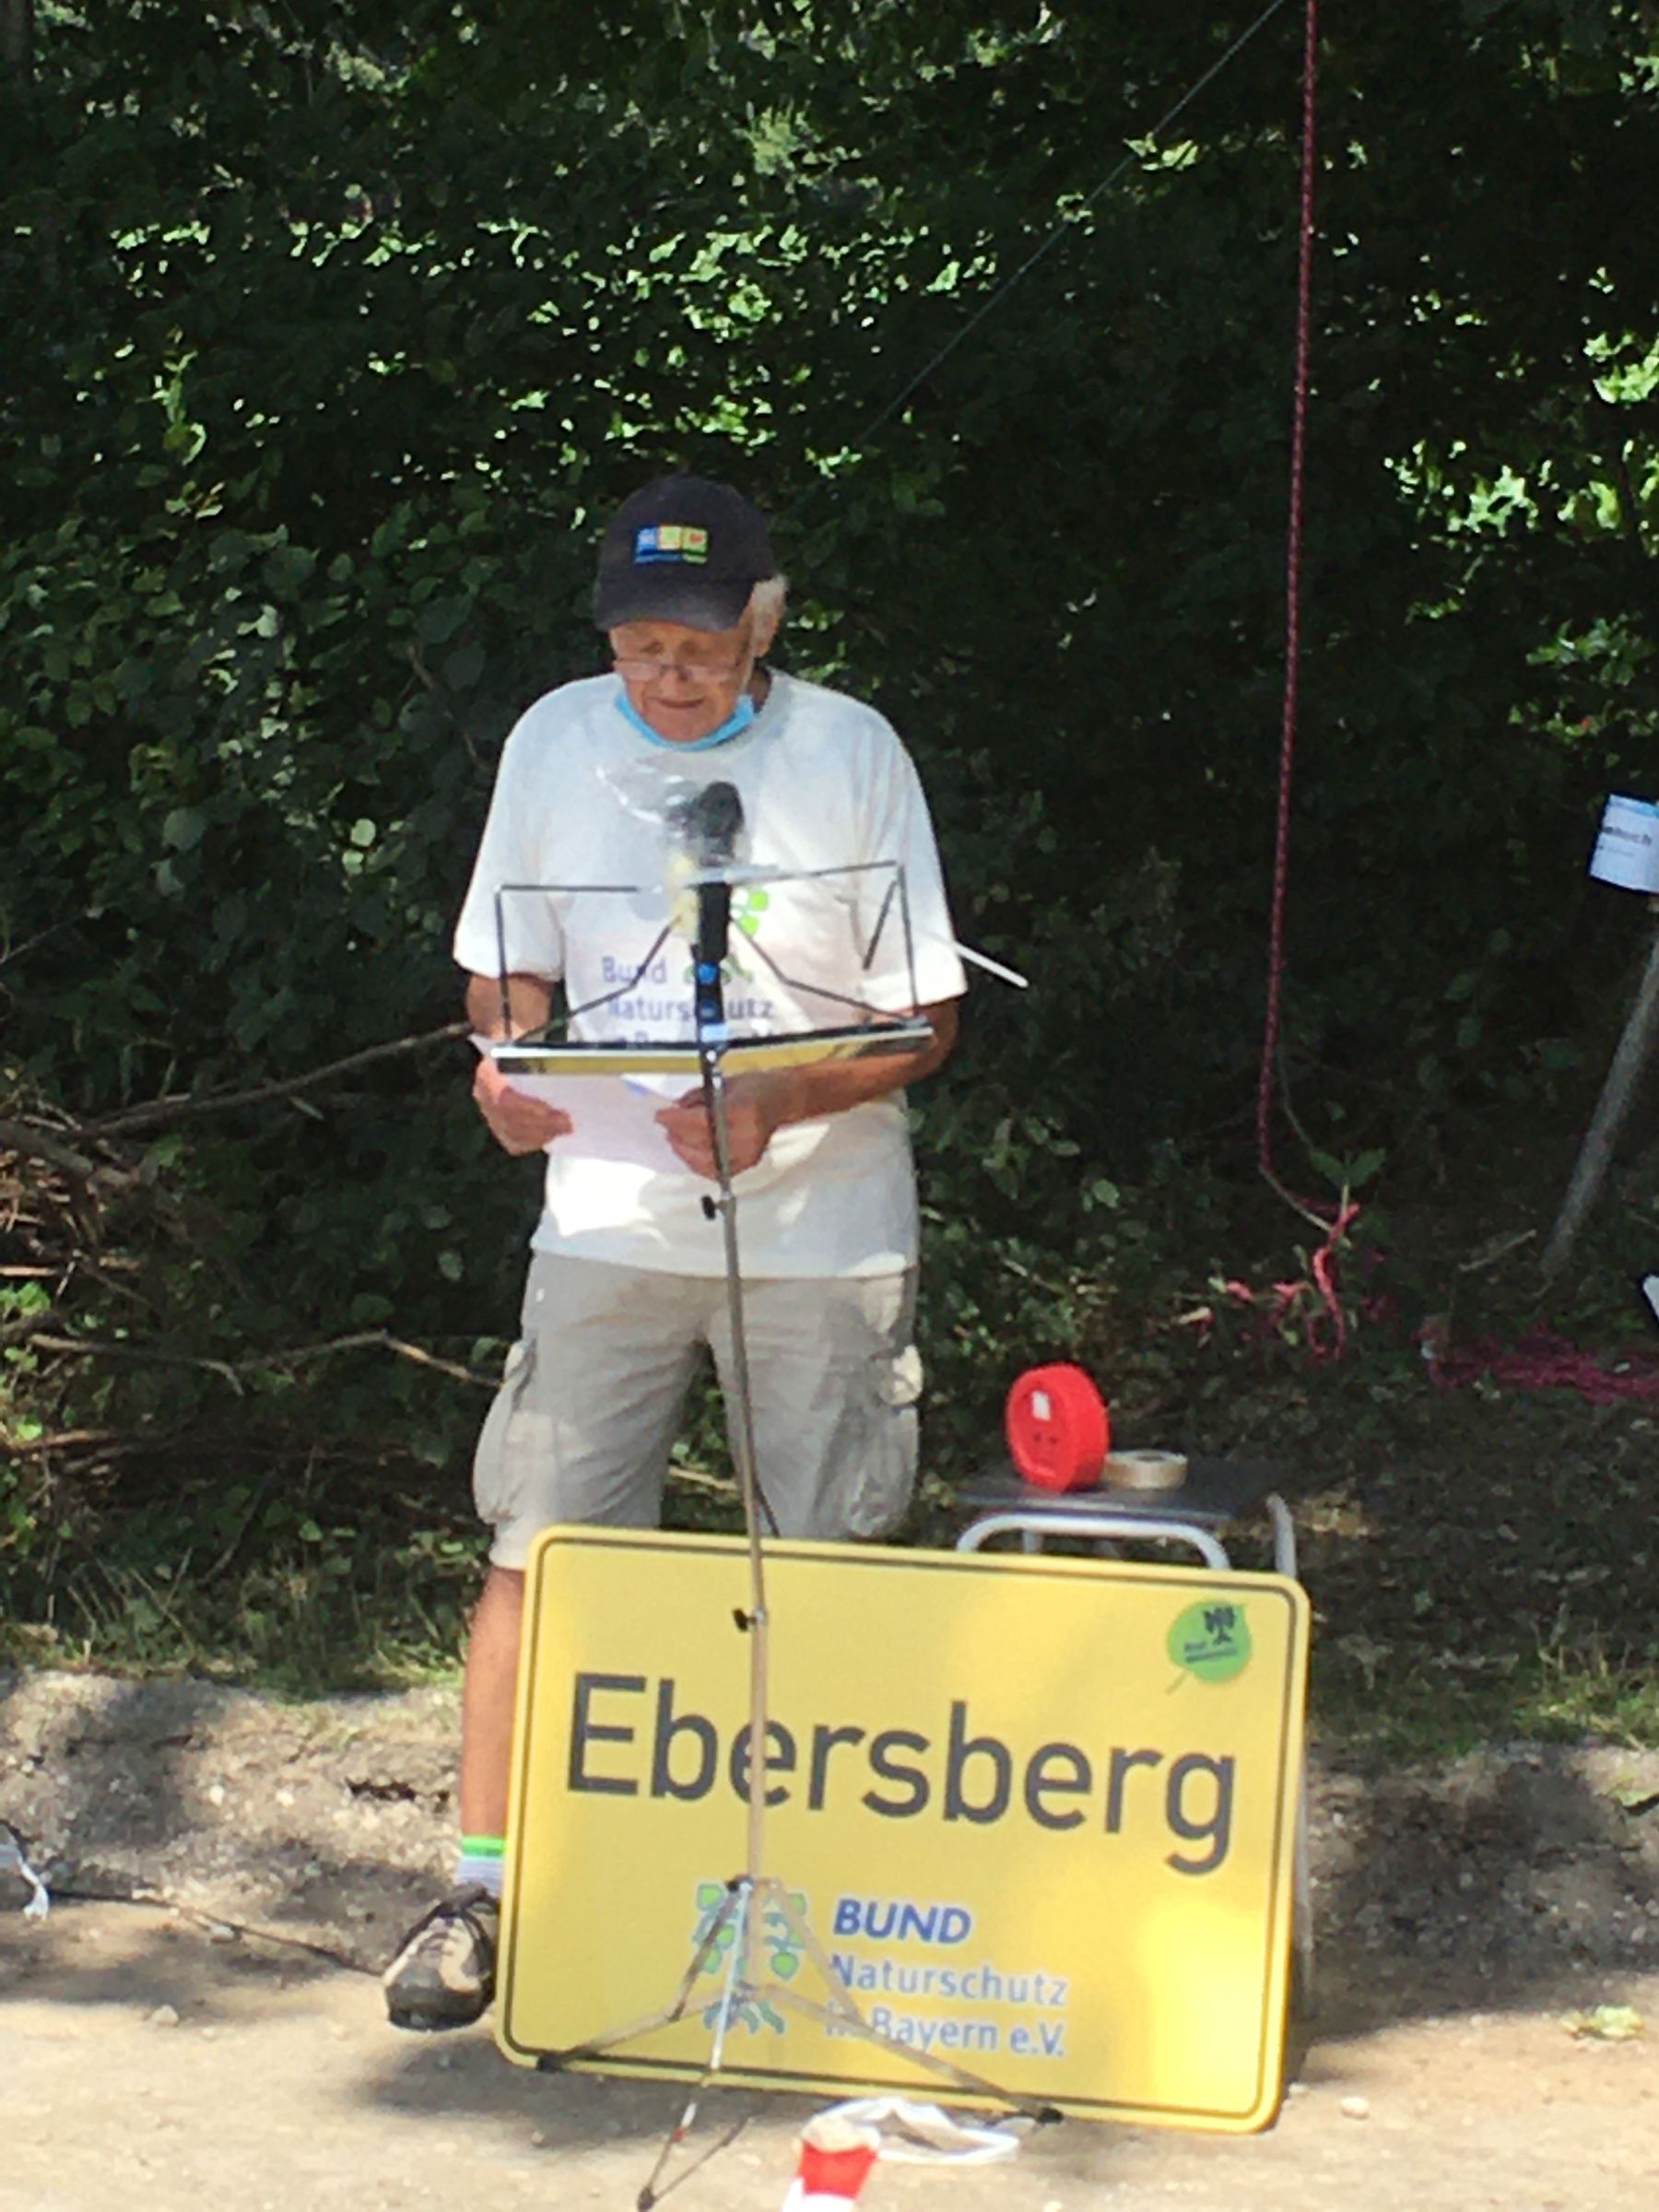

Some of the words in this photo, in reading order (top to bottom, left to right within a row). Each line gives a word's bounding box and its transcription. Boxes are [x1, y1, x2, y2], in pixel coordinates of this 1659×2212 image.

[567, 1672, 1237, 1876] Ebersberg
[833, 1899, 971, 1944] BUND
[831, 1954, 1068, 2006] Naturschutz
[1010, 2023, 1065, 2057] e.V.
